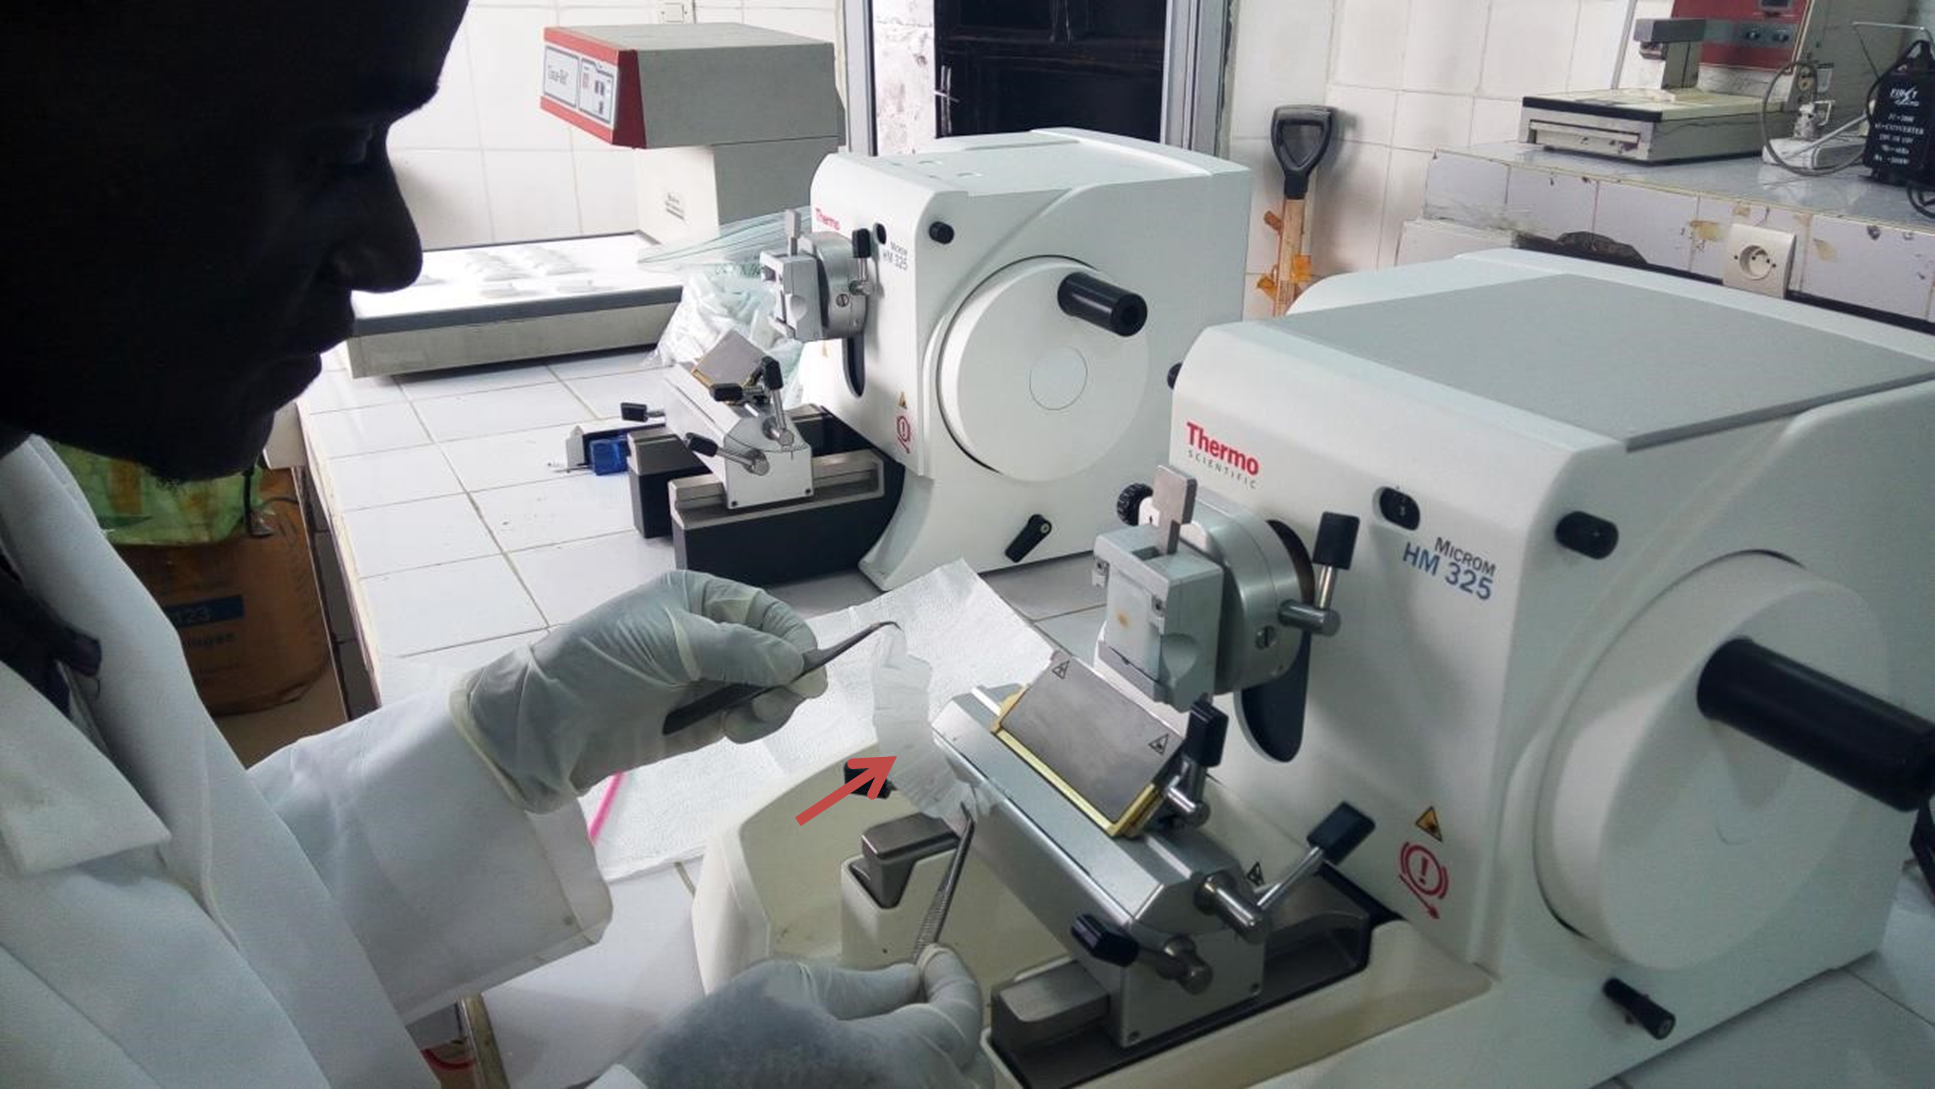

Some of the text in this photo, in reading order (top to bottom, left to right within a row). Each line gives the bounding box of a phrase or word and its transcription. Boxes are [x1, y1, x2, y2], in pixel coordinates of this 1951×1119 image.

[1186, 421, 1259, 476] Thermo
[1187, 450, 1257, 490] SCIENTIFIC
[1402, 542, 1494, 601] HM 325
